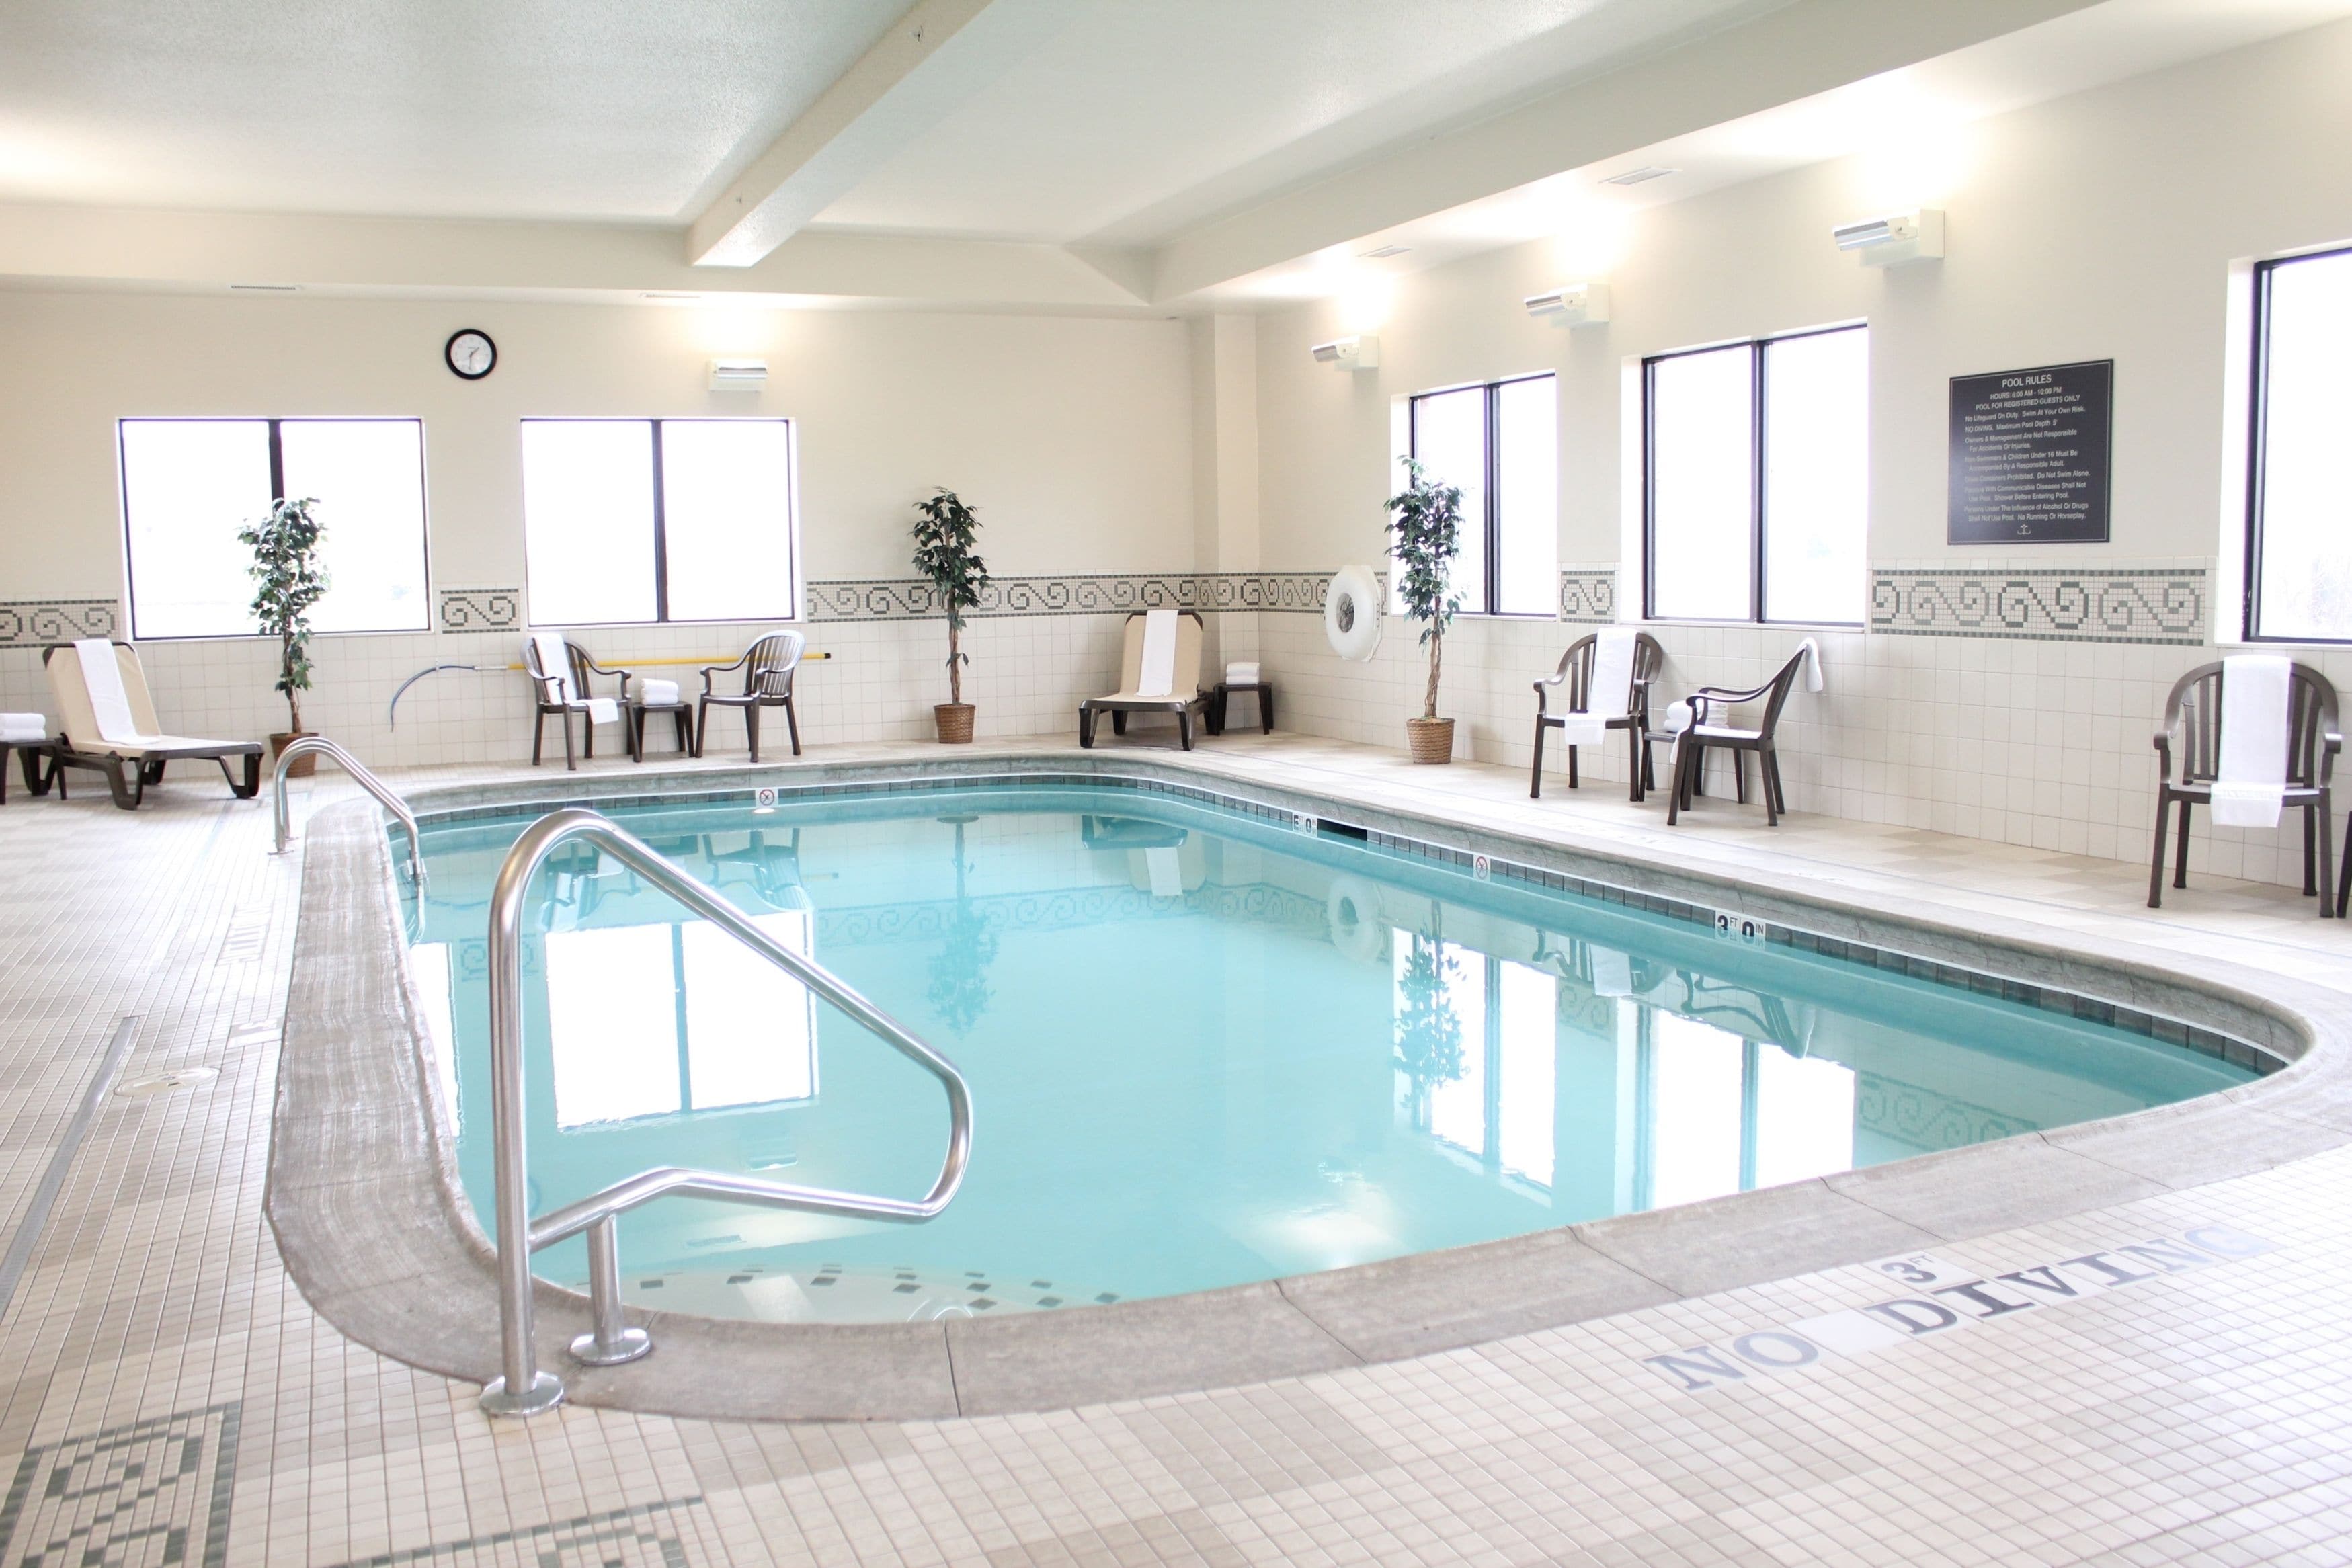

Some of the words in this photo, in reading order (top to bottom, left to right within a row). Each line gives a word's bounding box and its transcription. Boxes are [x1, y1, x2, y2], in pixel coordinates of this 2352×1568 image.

[2002, 378, 2023, 388] POOL
[2025, 374, 2052, 385] RULES
[2004, 399, 2038, 408] REGISTERED
[2040, 396, 2062, 405] GUESTS
[1974, 413, 1996, 421] Lifeguard
[1990, 434, 2022, 442] Management
[2044, 429, 2077, 438] Responsible
[1979, 444, 2002, 452] Accidents
[2032, 492, 2054, 500] Entering
[2027, 512, 2048, 521] Running
[1730, 917, 1738, 928] FT
[1756, 923, 1765, 935] IN
[1881, 1262, 1937, 1284] 3
[1644, 1331, 1820, 1391] NO
[1863, 1224, 2265, 1335] DIVING
